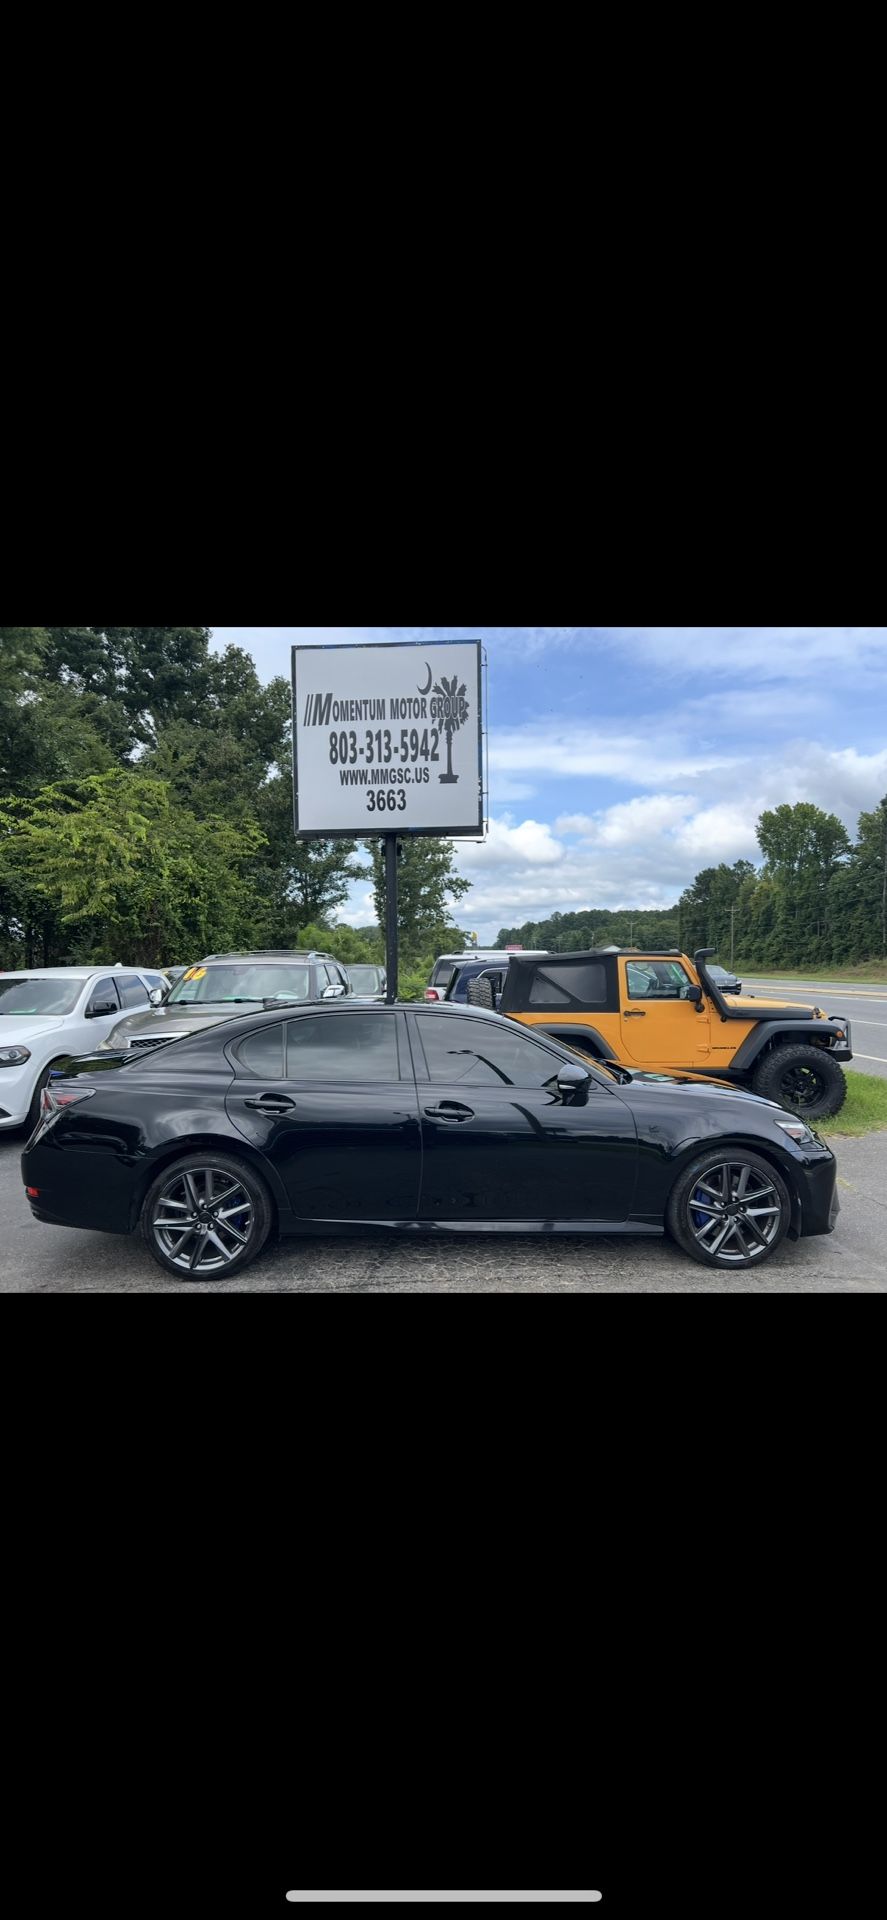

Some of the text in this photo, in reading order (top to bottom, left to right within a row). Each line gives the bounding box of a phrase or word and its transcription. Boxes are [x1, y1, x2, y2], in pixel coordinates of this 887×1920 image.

[390, 698, 427, 720] MOTOR
[429, 697, 465, 719] GROUP
[329, 728, 439, 765] 803-313-5942
[339, 767, 430, 785] WWW.MMGSC.US
[366, 789, 407, 811] 3663
